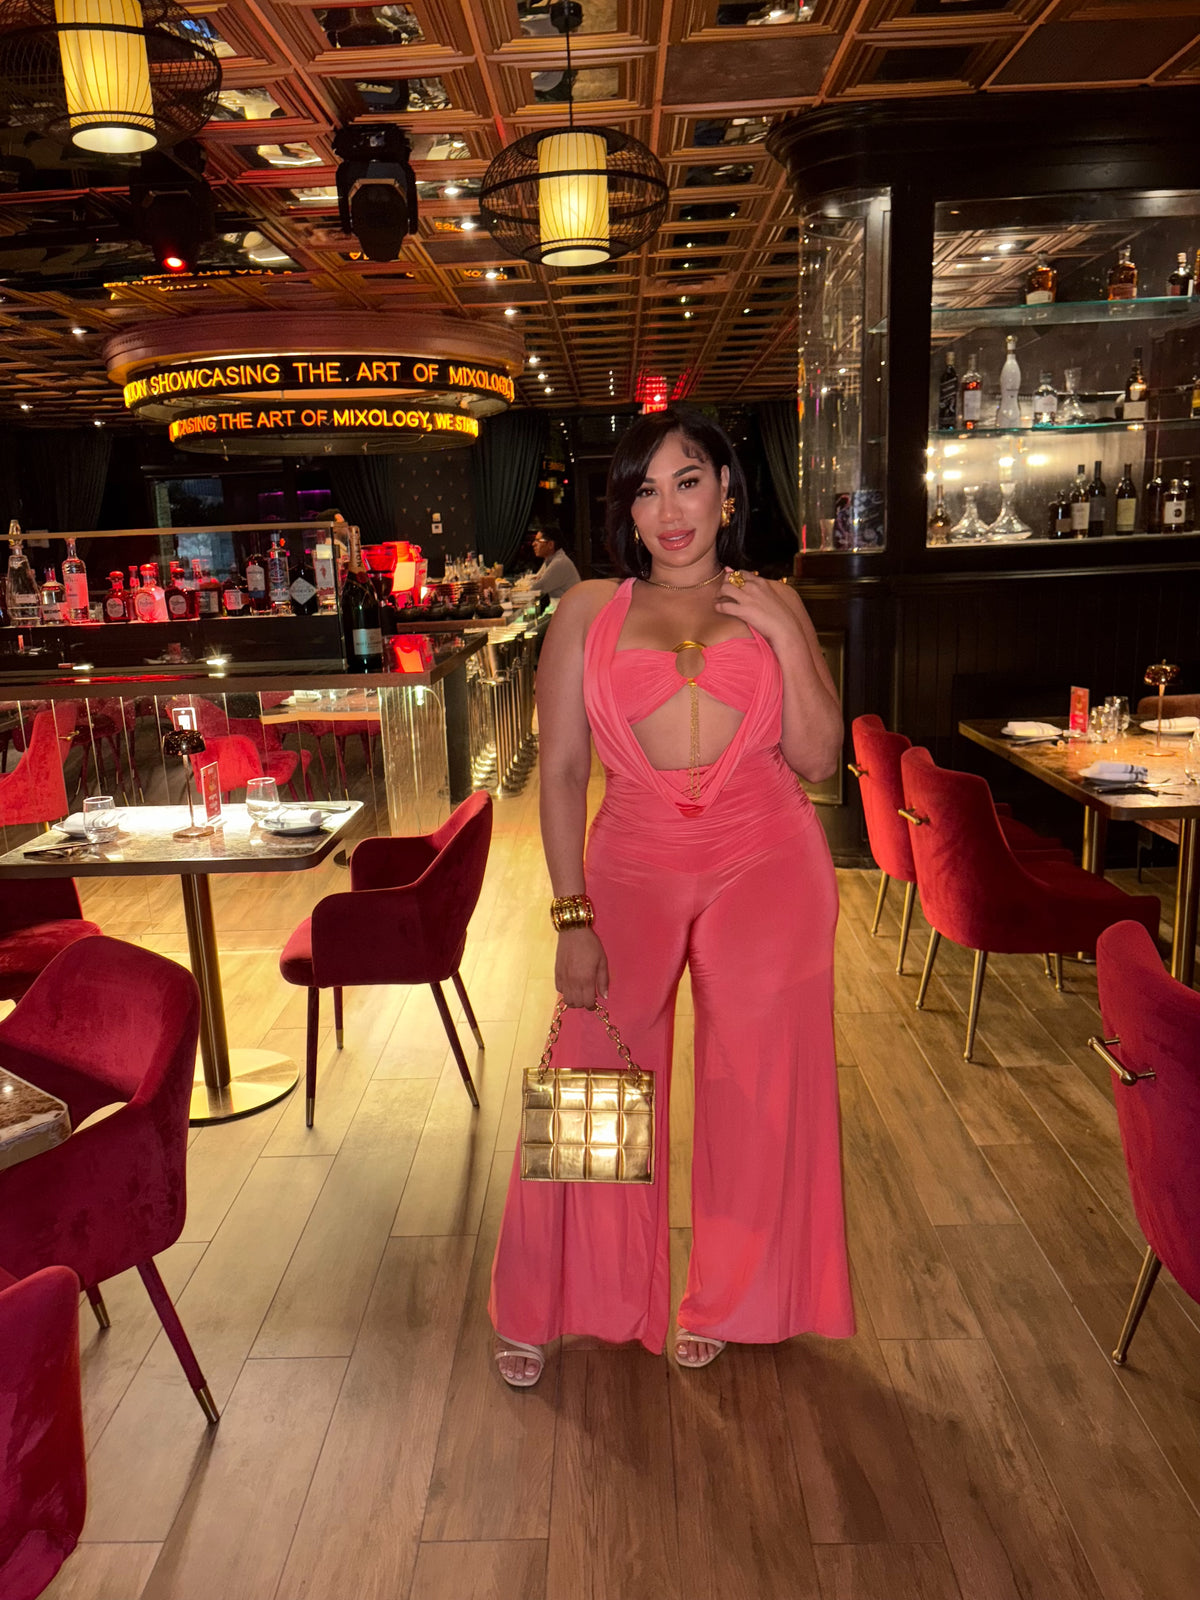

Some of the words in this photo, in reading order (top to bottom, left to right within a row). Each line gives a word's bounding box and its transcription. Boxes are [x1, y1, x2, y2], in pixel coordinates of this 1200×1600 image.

[150, 363, 280, 396] SHOWCASING
[292, 362, 342, 383] THE
[356, 361, 401, 382] ART
[412, 362, 439, 383] OF
[218, 411, 253, 429] THE
[256, 409, 296, 429] ART
[300, 408, 328, 427] OF
[332, 408, 433, 433] MIXOLOGY,
[433, 412, 454, 430] WE
